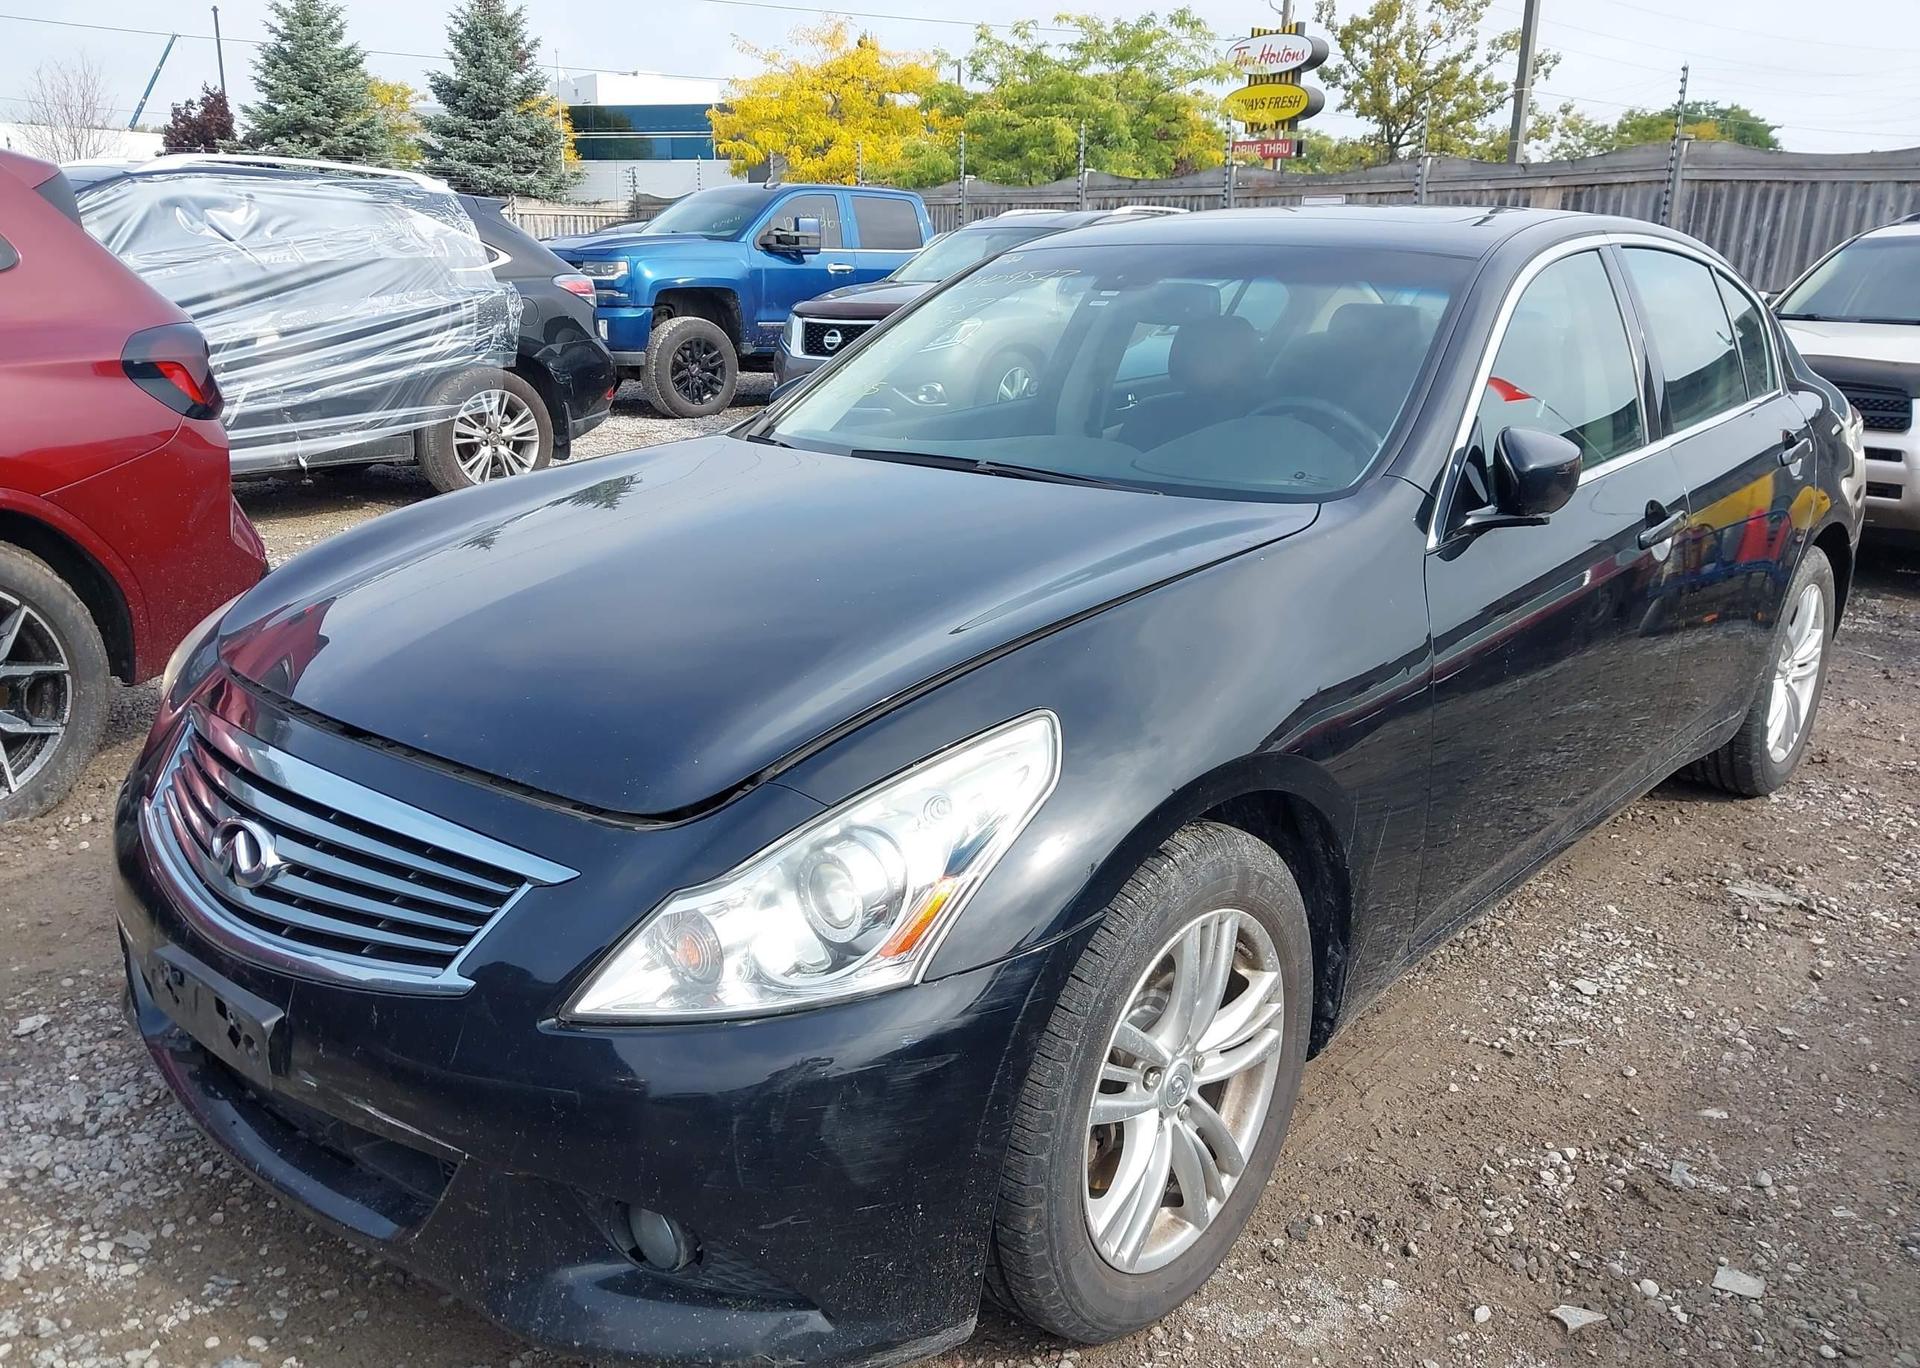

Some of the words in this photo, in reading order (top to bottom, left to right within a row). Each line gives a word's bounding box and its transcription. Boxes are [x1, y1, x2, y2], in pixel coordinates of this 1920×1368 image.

[1258, 43, 1305, 64] Hortons
[1267, 95, 1303, 110] FRESH
[1234, 144, 1262, 155] DRIVE
[1264, 142, 1290, 154] THRU
